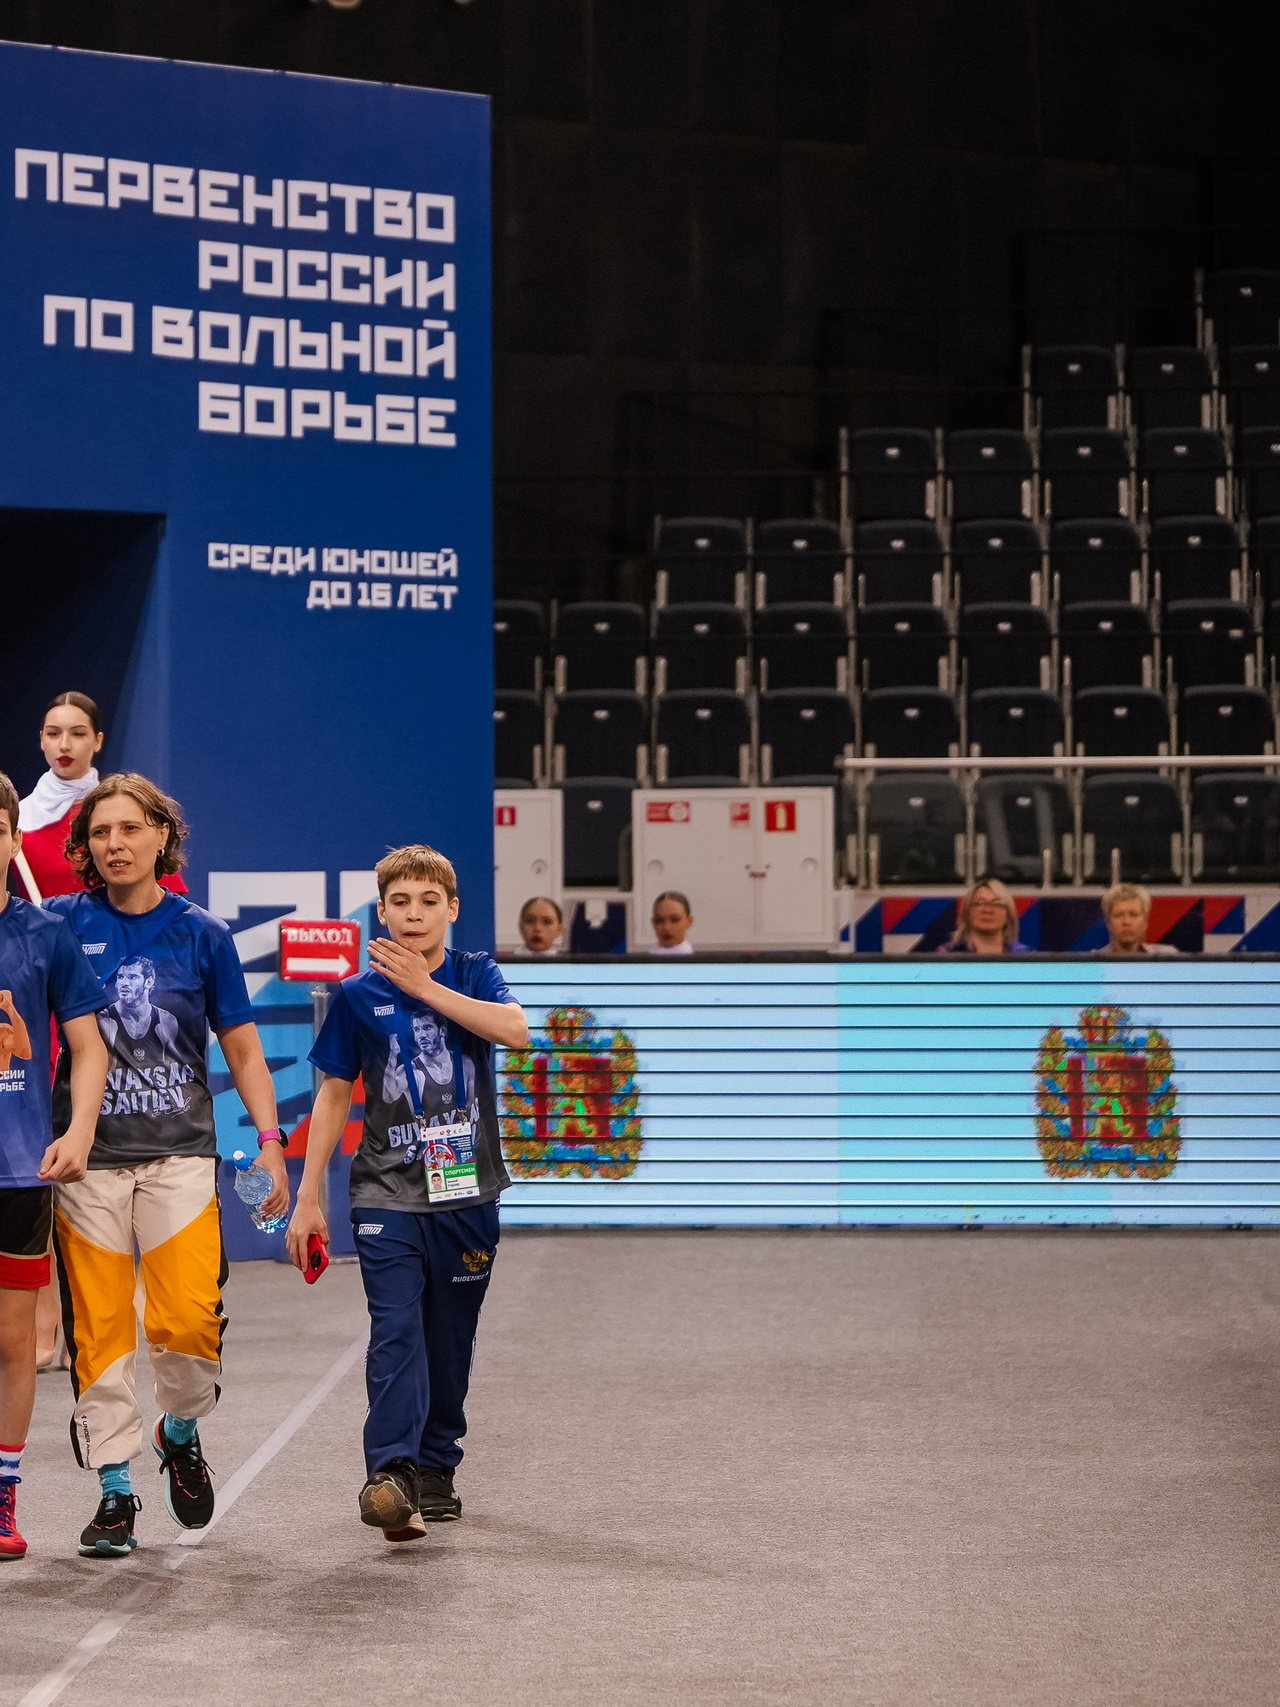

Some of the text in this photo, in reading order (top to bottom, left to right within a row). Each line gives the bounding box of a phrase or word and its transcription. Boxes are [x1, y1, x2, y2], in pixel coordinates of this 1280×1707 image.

[15, 148, 456, 243] ПЕРВЕНСТВО
[198, 240, 456, 311] РОССИИ
[43, 294, 456, 379] ПО ВОЛЬНОЙ
[198, 381, 456, 447] БОРЬБЕ
[208, 542, 458, 578] СРЕДИ ЮНОШЕЙ
[306, 580, 458, 610] ДО 16 ЛЕТ
[287, 927, 354, 946] ВЫХОД
[100, 1086, 186, 1115] SAITIEV
[445, 1167, 475, 1176] СПОРТСМЕН
